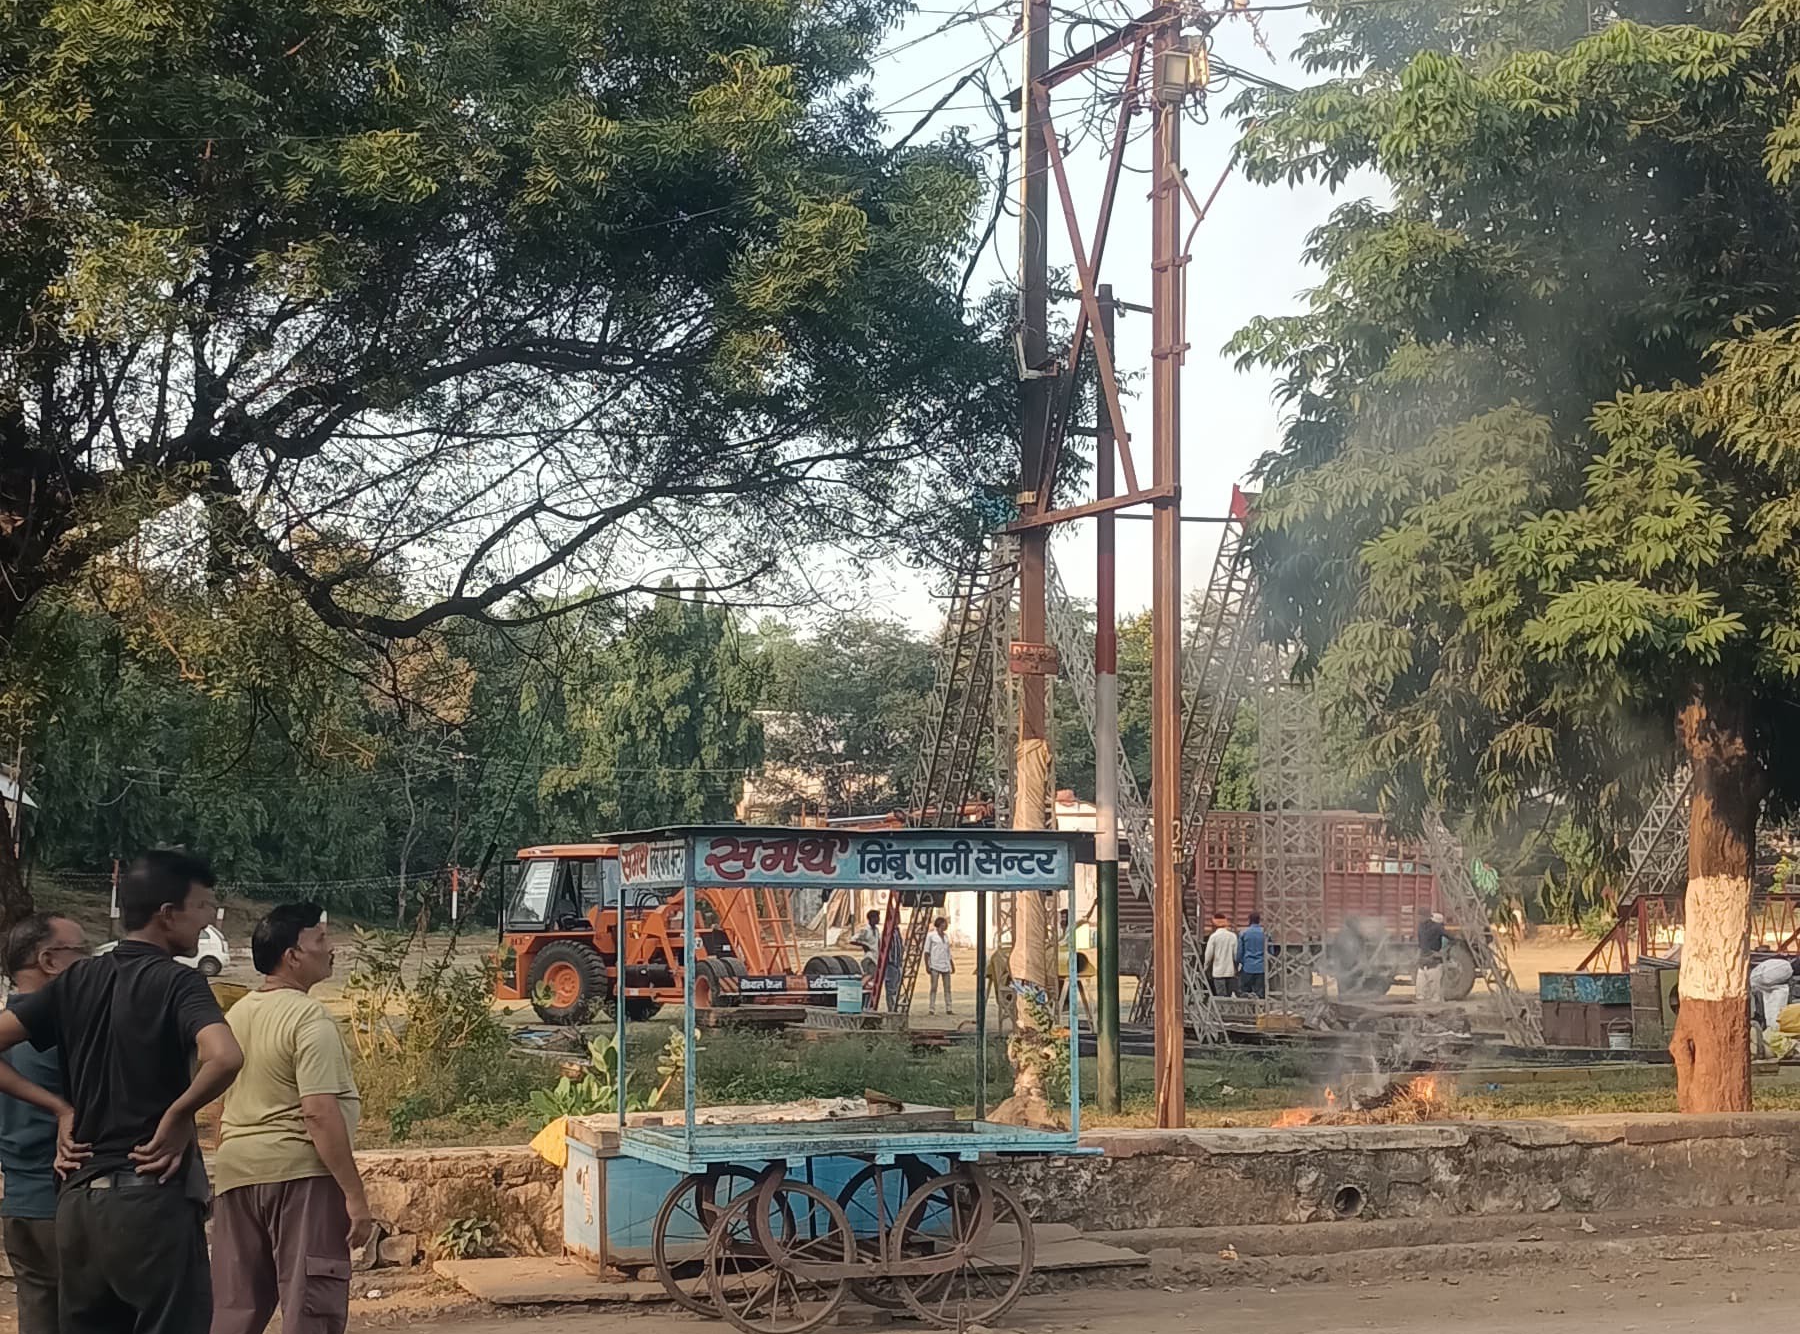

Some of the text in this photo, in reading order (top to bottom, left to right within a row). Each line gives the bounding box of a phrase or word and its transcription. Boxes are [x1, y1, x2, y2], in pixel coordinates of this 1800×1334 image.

[704, 835, 1057, 881] समर्थ निंबू पानी सेन्टर
